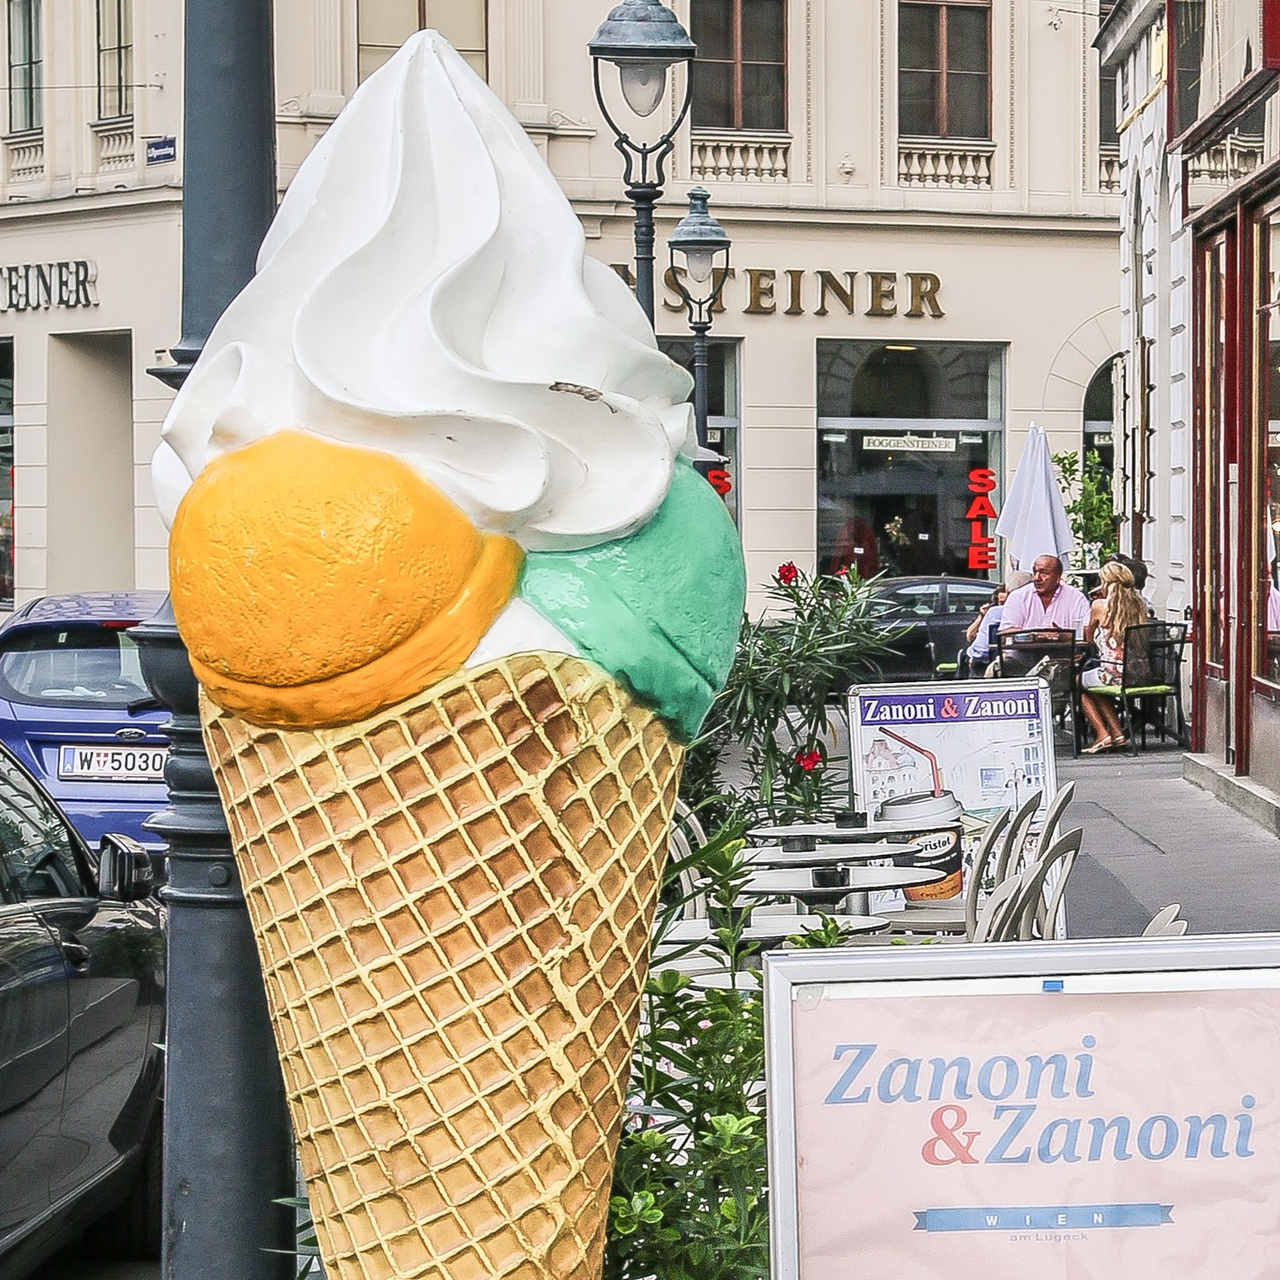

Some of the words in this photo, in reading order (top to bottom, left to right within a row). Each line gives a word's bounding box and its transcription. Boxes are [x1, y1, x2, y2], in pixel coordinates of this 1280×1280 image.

[867, 438, 952, 450] FOGGENSTEINER
[965, 468, 998, 569] SALE
[864, 697, 936, 722] Zanoni
[940, 697, 960, 718] &
[964, 693, 1037, 718] Zanoni
[79, 752, 94, 771] W
[823, 1034, 1097, 1106] Zanoni
[985, 1213, 1103, 1227] WIEN
